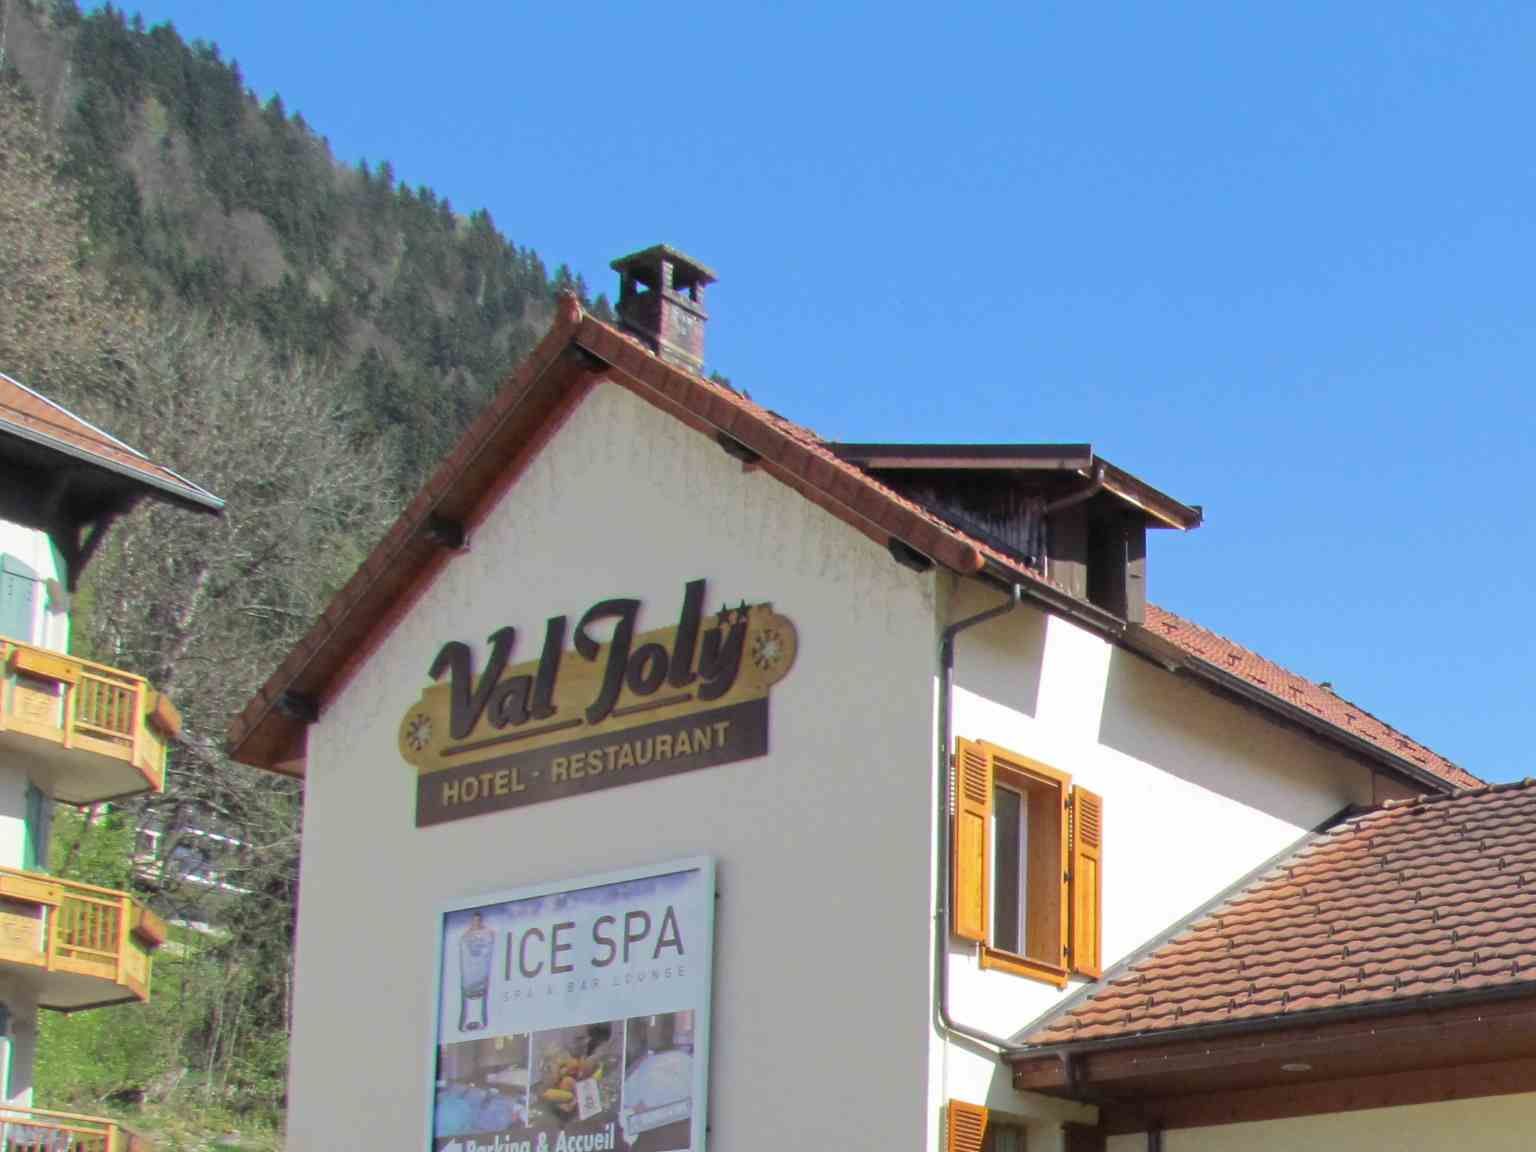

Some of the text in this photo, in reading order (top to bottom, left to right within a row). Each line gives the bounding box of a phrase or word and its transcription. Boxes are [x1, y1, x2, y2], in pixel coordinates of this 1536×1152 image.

[428, 578, 750, 740] Val Joly
[442, 767, 525, 806] HOTEL
[551, 721, 730, 783] RESTAURANT
[504, 905, 685, 981] ICE SPA
